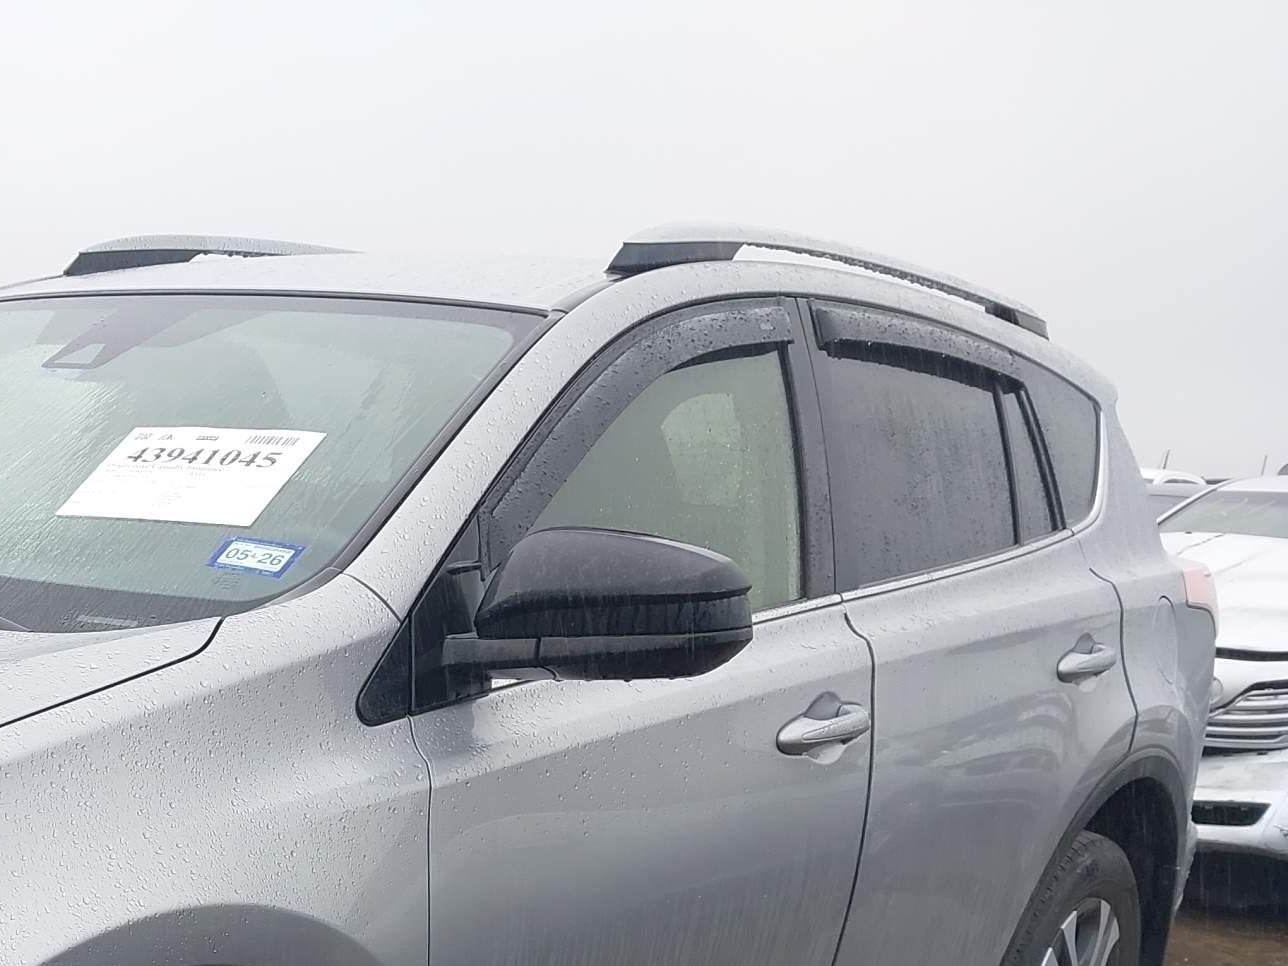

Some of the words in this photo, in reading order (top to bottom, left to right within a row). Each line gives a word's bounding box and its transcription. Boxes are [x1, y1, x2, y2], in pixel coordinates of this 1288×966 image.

[126, 446, 283, 468] 43941045
[225, 548, 252, 561] 05
[256, 552, 285, 566] 26
